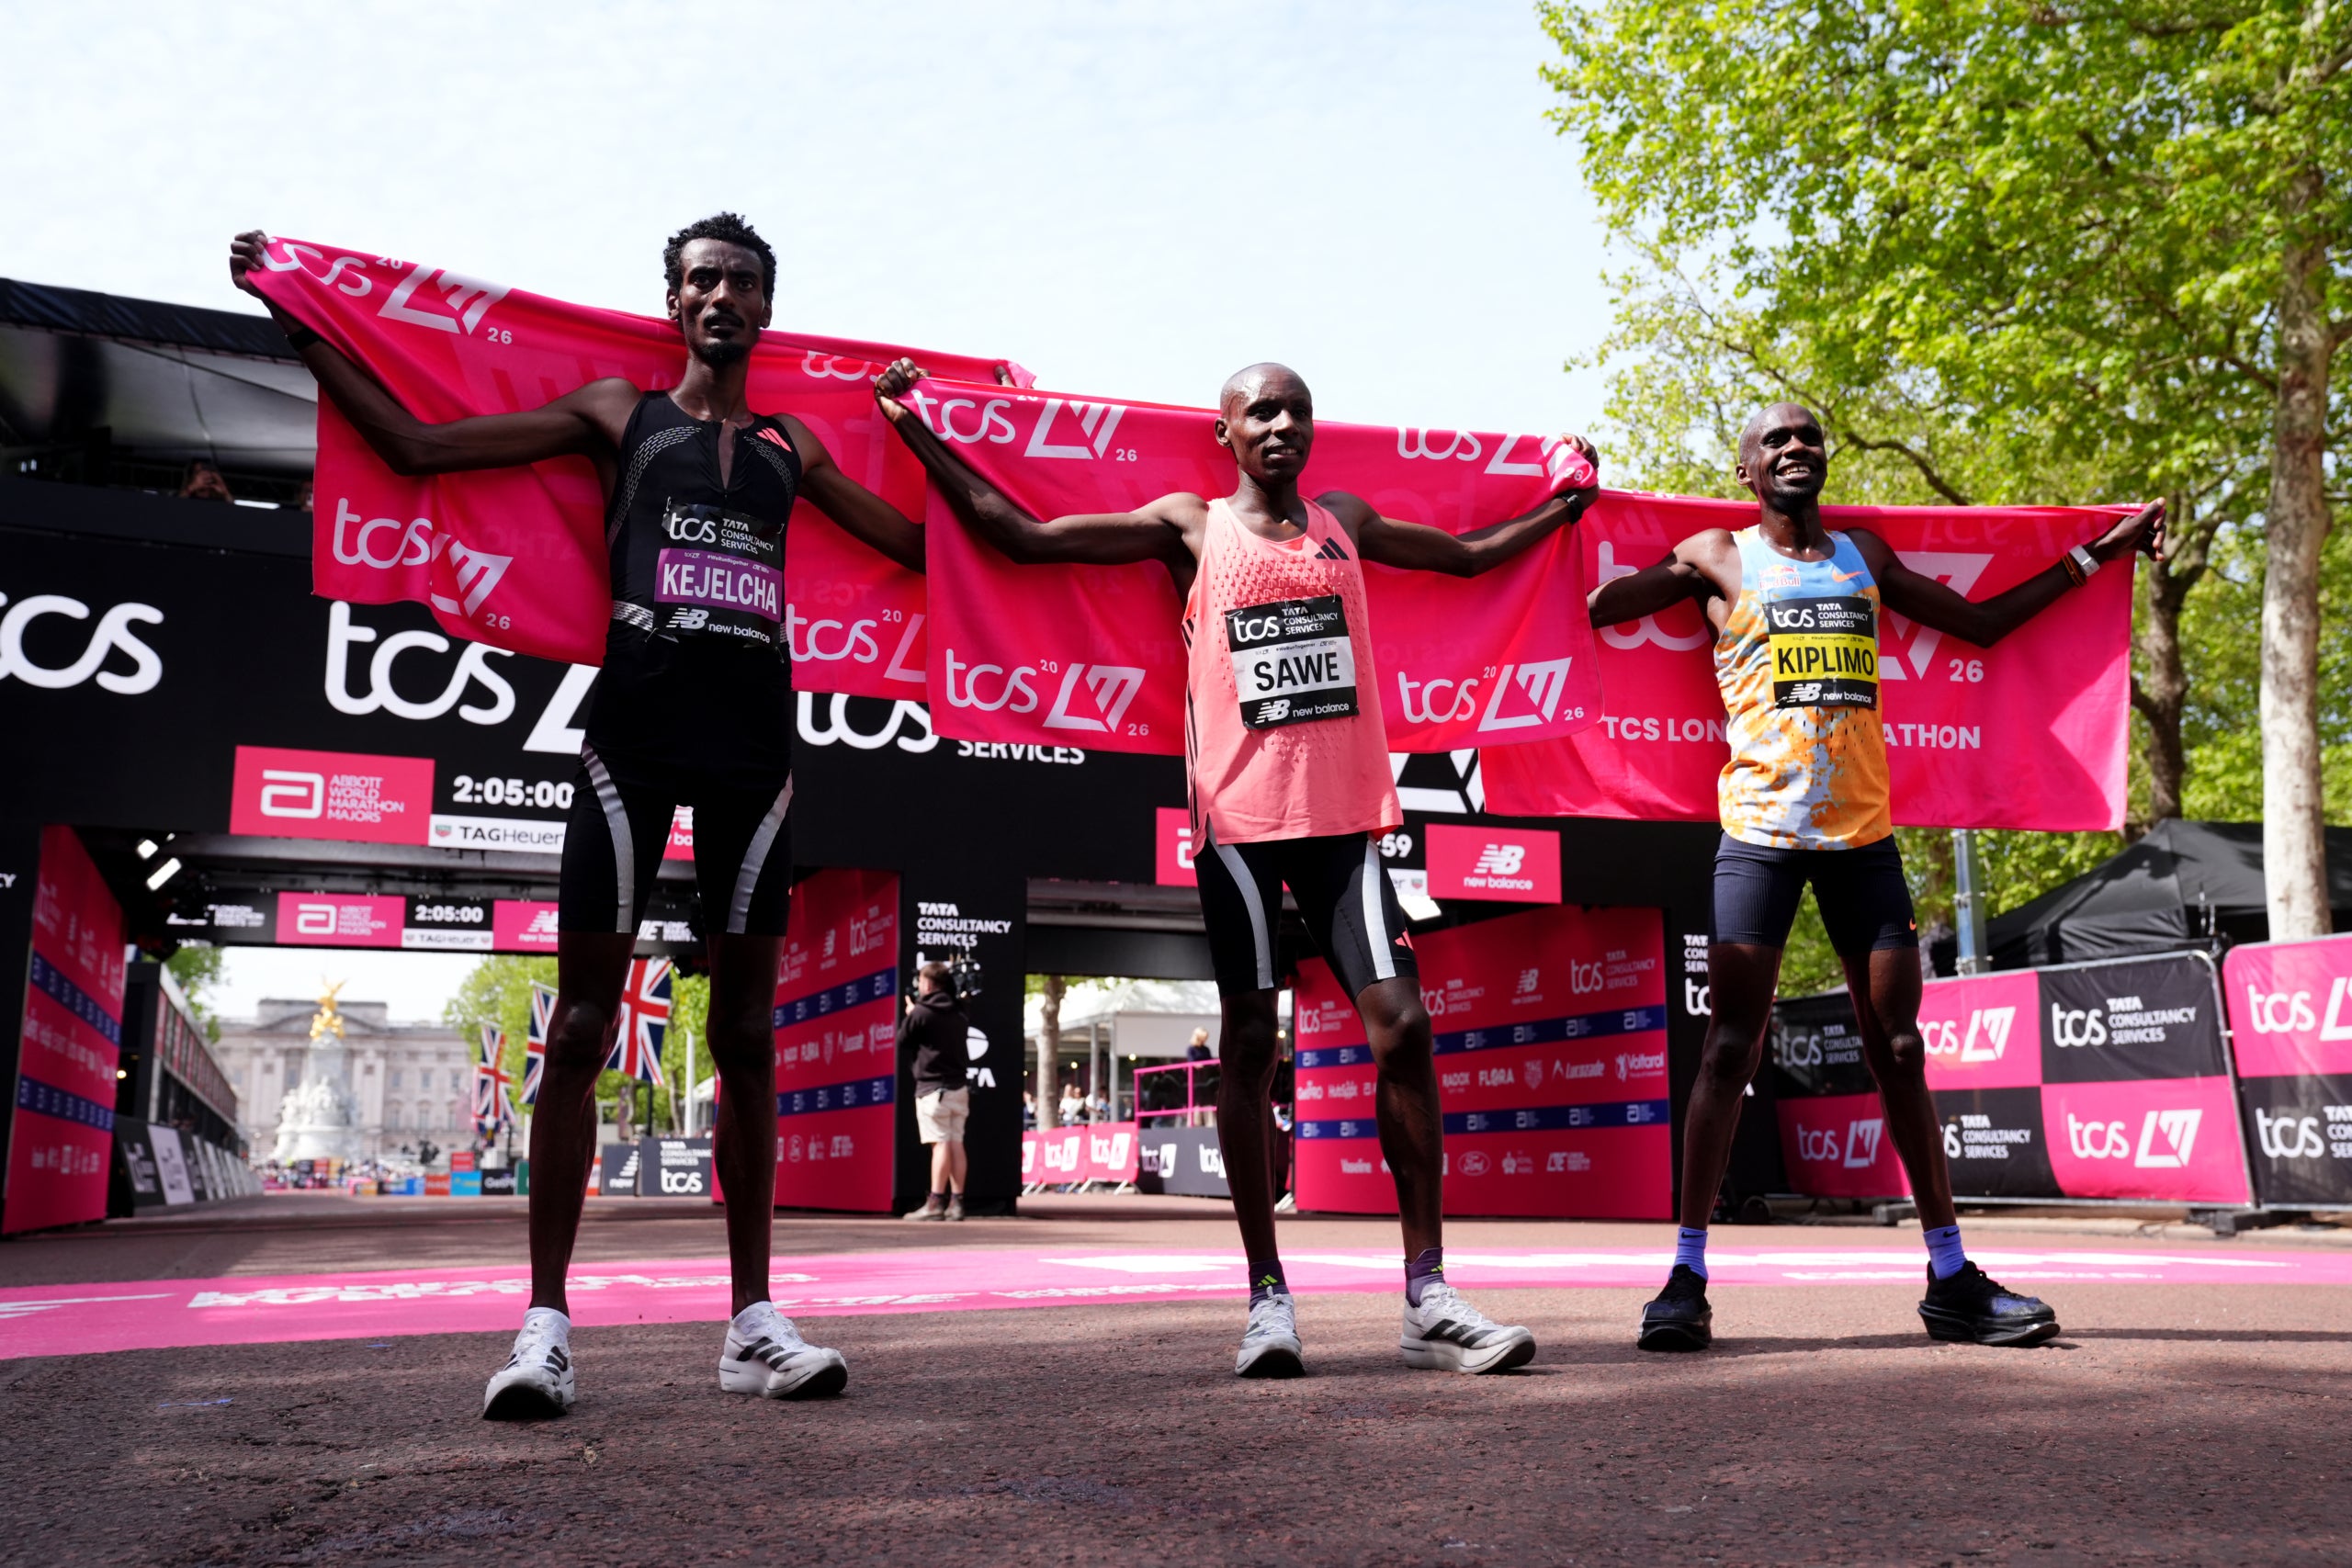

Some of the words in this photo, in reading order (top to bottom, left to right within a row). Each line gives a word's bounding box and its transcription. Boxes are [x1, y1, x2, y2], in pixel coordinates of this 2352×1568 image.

[487, 327, 513, 344] 26
[911, 389, 1016, 444] tcs
[1115, 447, 1137, 462] 26
[333, 497, 433, 570] tcs
[669, 512, 717, 544] tcs
[722, 518, 749, 532] TATA
[720, 528, 775, 551] CONSULTANCY
[720, 538, 759, 555] SERVICES
[662, 563, 777, 615] KEJELCHA
[1282, 606, 1308, 616] TATA
[1816, 603, 1841, 612] TATA
[485, 613, 511, 630] 26
[1283, 613, 1339, 626] CONSULTANCY
[1772, 608, 1815, 628] tcs
[1817, 612, 1869, 622] CONSULTANCY
[1819, 620, 1855, 628] SERVICES
[708, 623, 732, 635] new
[734, 626, 771, 643] balance
[786, 604, 879, 663] tcs
[882, 608, 902, 623] 20
[1234, 615, 1280, 643] tcs
[1285, 623, 1324, 636] SERVICES
[0, 592, 164, 695] cs
[324, 600, 516, 726] tcs
[1778, 647, 1874, 676] KIPLIMO
[1253, 652, 1340, 692] SAWE
[1950, 659, 1984, 682] 26
[945, 649, 1038, 714] tcs
[1040, 659, 1058, 674] 20
[1397, 671, 1479, 724] tcs
[1483, 666, 1497, 679] 20
[1823, 692, 1842, 701] new
[1844, 691, 1871, 704] balance
[1293, 706, 1313, 718] new
[1315, 703, 1350, 716] balance
[1564, 706, 1585, 721] 26
[1127, 723, 1150, 737] 26
[1604, 716, 1665, 741] TCS
[1668, 719, 1728, 743] LON
[1881, 724, 1981, 749] ATHON
[957, 740, 1086, 765] SERVICES
[330, 774, 384, 789] ABBOTT
[329, 786, 380, 800] WORLD
[453, 774, 575, 809] 2:05:00
[328, 796, 404, 813] MARATHON
[327, 808, 382, 823] MAJORS
[1464, 876, 1487, 887] new
[1488, 877, 1533, 890] balance
[414, 905, 484, 923] 2:05:00
[917, 902, 958, 917] TATA
[917, 918, 1012, 934] CONSULTANCY
[518, 933, 537, 942] new
[917, 932, 978, 947] SERVICES
[1683, 934, 1708, 946] TAT
[1571, 958, 1603, 995] tcs
[1685, 977, 1712, 1016] tc
[2106, 996, 2143, 1012] TATA
[2247, 984, 2316, 1034] tcs
[1299, 1006, 1320, 1034] tcs
[2052, 1002, 2108, 1047] tcs
[2109, 1007, 2197, 1029] CONSULTANCY
[1823, 1024, 1846, 1037] TATA
[2110, 1027, 2166, 1044] SERVICES
[1781, 1025, 1822, 1066] tcs
[1826, 1050, 1860, 1064] SERVICES
[1961, 1114, 1991, 1129] TATA
[2323, 1105, 2352, 1122] TAT
[1796, 1123, 1838, 1161] tcs
[1962, 1129, 2031, 1145] CONSULTANCY
[2067, 1112, 2130, 1159] tcs
[2256, 1108, 2324, 1159] tcs
[1963, 1145, 2009, 1159] SERVICES
[661, 1168, 703, 1193] tcs
